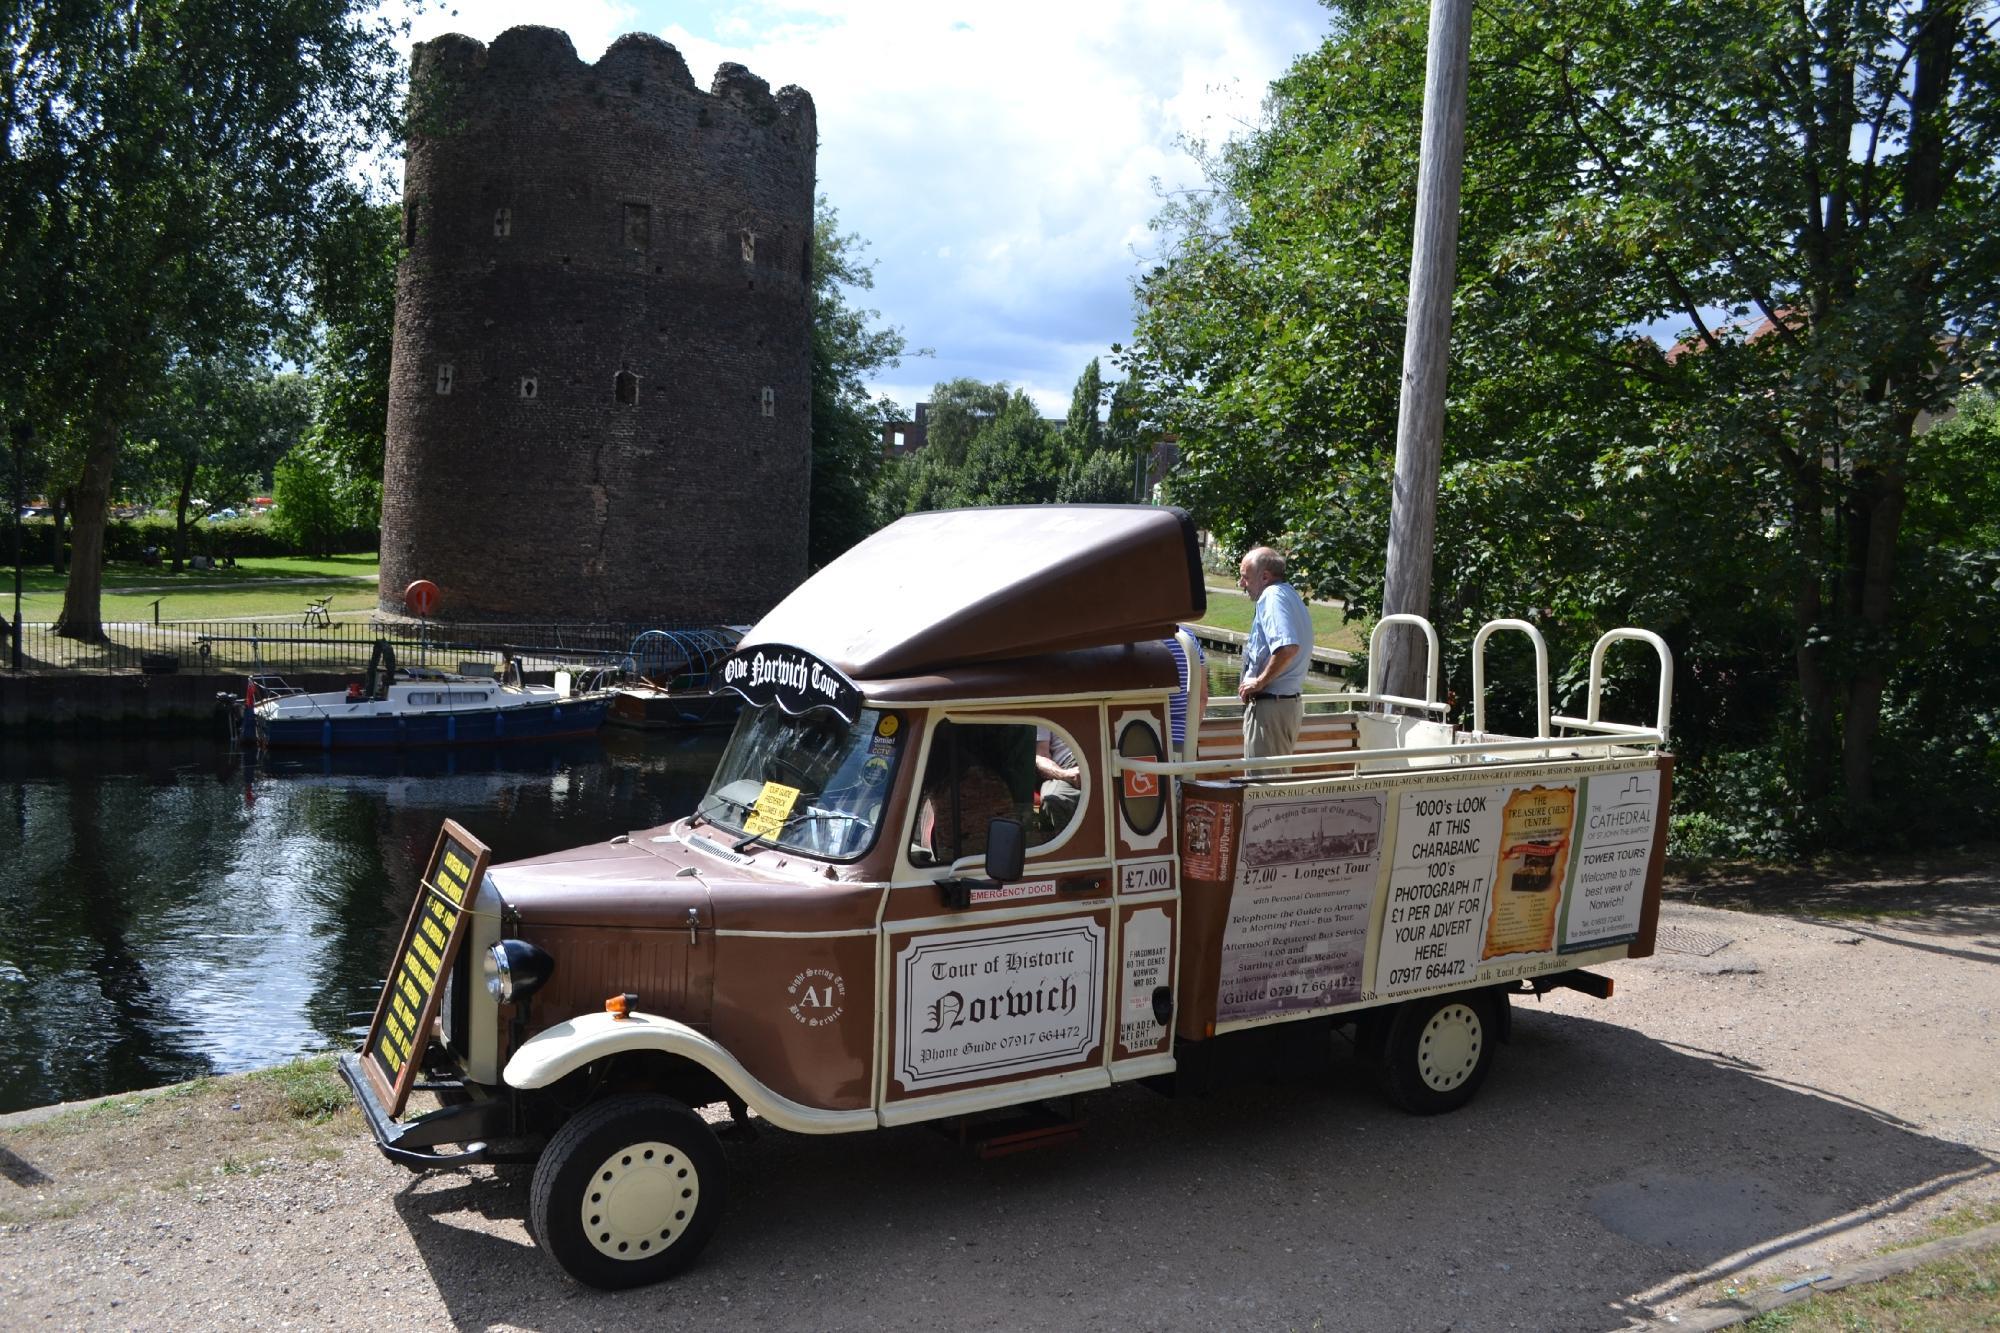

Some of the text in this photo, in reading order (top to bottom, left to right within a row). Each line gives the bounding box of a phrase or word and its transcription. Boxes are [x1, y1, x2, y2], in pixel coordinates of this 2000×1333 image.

[725, 652, 839, 700] Olde Norwich Tour
[1416, 796, 1487, 816] 1000's LOOK
[1428, 818, 1471, 837] AT THIS
[1590, 809, 1651, 829] CATHEDRAL
[1412, 838, 1480, 860] CHARABANC
[1584, 848, 1646, 866] TOWER TOURS
[1125, 867, 1167, 889] £7.00
[1244, 868, 1278, 885] £7.00
[1294, 865, 1341, 880] Longest
[1344, 862, 1371, 875] Tour
[1427, 862, 1455, 878] 100's
[1580, 867, 1642, 884] Welcome to the
[971, 884, 1053, 900] EMERGENCY DOOR
[1253, 897, 1270, 905] with
[1271, 893, 1303, 903] Personal
[1395, 878, 1484, 902] PHOTOGRAPH IT
[1585, 881, 1633, 897] best view of
[1232, 902, 1368, 925] Telephone the Guide to Arrange
[1391, 898, 1480, 923] £1 PER DAY FOR
[1589, 896, 1624, 911] Norwich!
[1250, 921, 1287, 933] Morning
[1318, 916, 1333, 925] Bus
[1395, 925, 1426, 943] YOUR
[1429, 918, 1472, 939] ADVERT
[1224, 928, 1366, 952] Afternoon Registered Bus Service
[1287, 946, 1305, 955] and
[1238, 951, 1348, 972] Starting at Castle Meadow
[1415, 943, 1448, 961] HERE!
[931, 947, 1074, 981] Tour of Historic
[1133, 968, 1158, 977] NORWICH
[1390, 966, 1422, 985] 07917
[1426, 960, 1465, 980] 664472
[787, 968, 846, 997] Sight Seeing Tour
[1224, 976, 1357, 1005] Guide 07917 664472
[799, 985, 833, 1008] A1
[921, 975, 1077, 1034] Norwich
[788, 1004, 844, 1027] Bus Service
[1121, 1020, 1156, 1033] UNLADEN
[1121, 1029, 1149, 1042] WEIGHT
[920, 1026, 1080, 1063] Phone Guide 07917 664472
